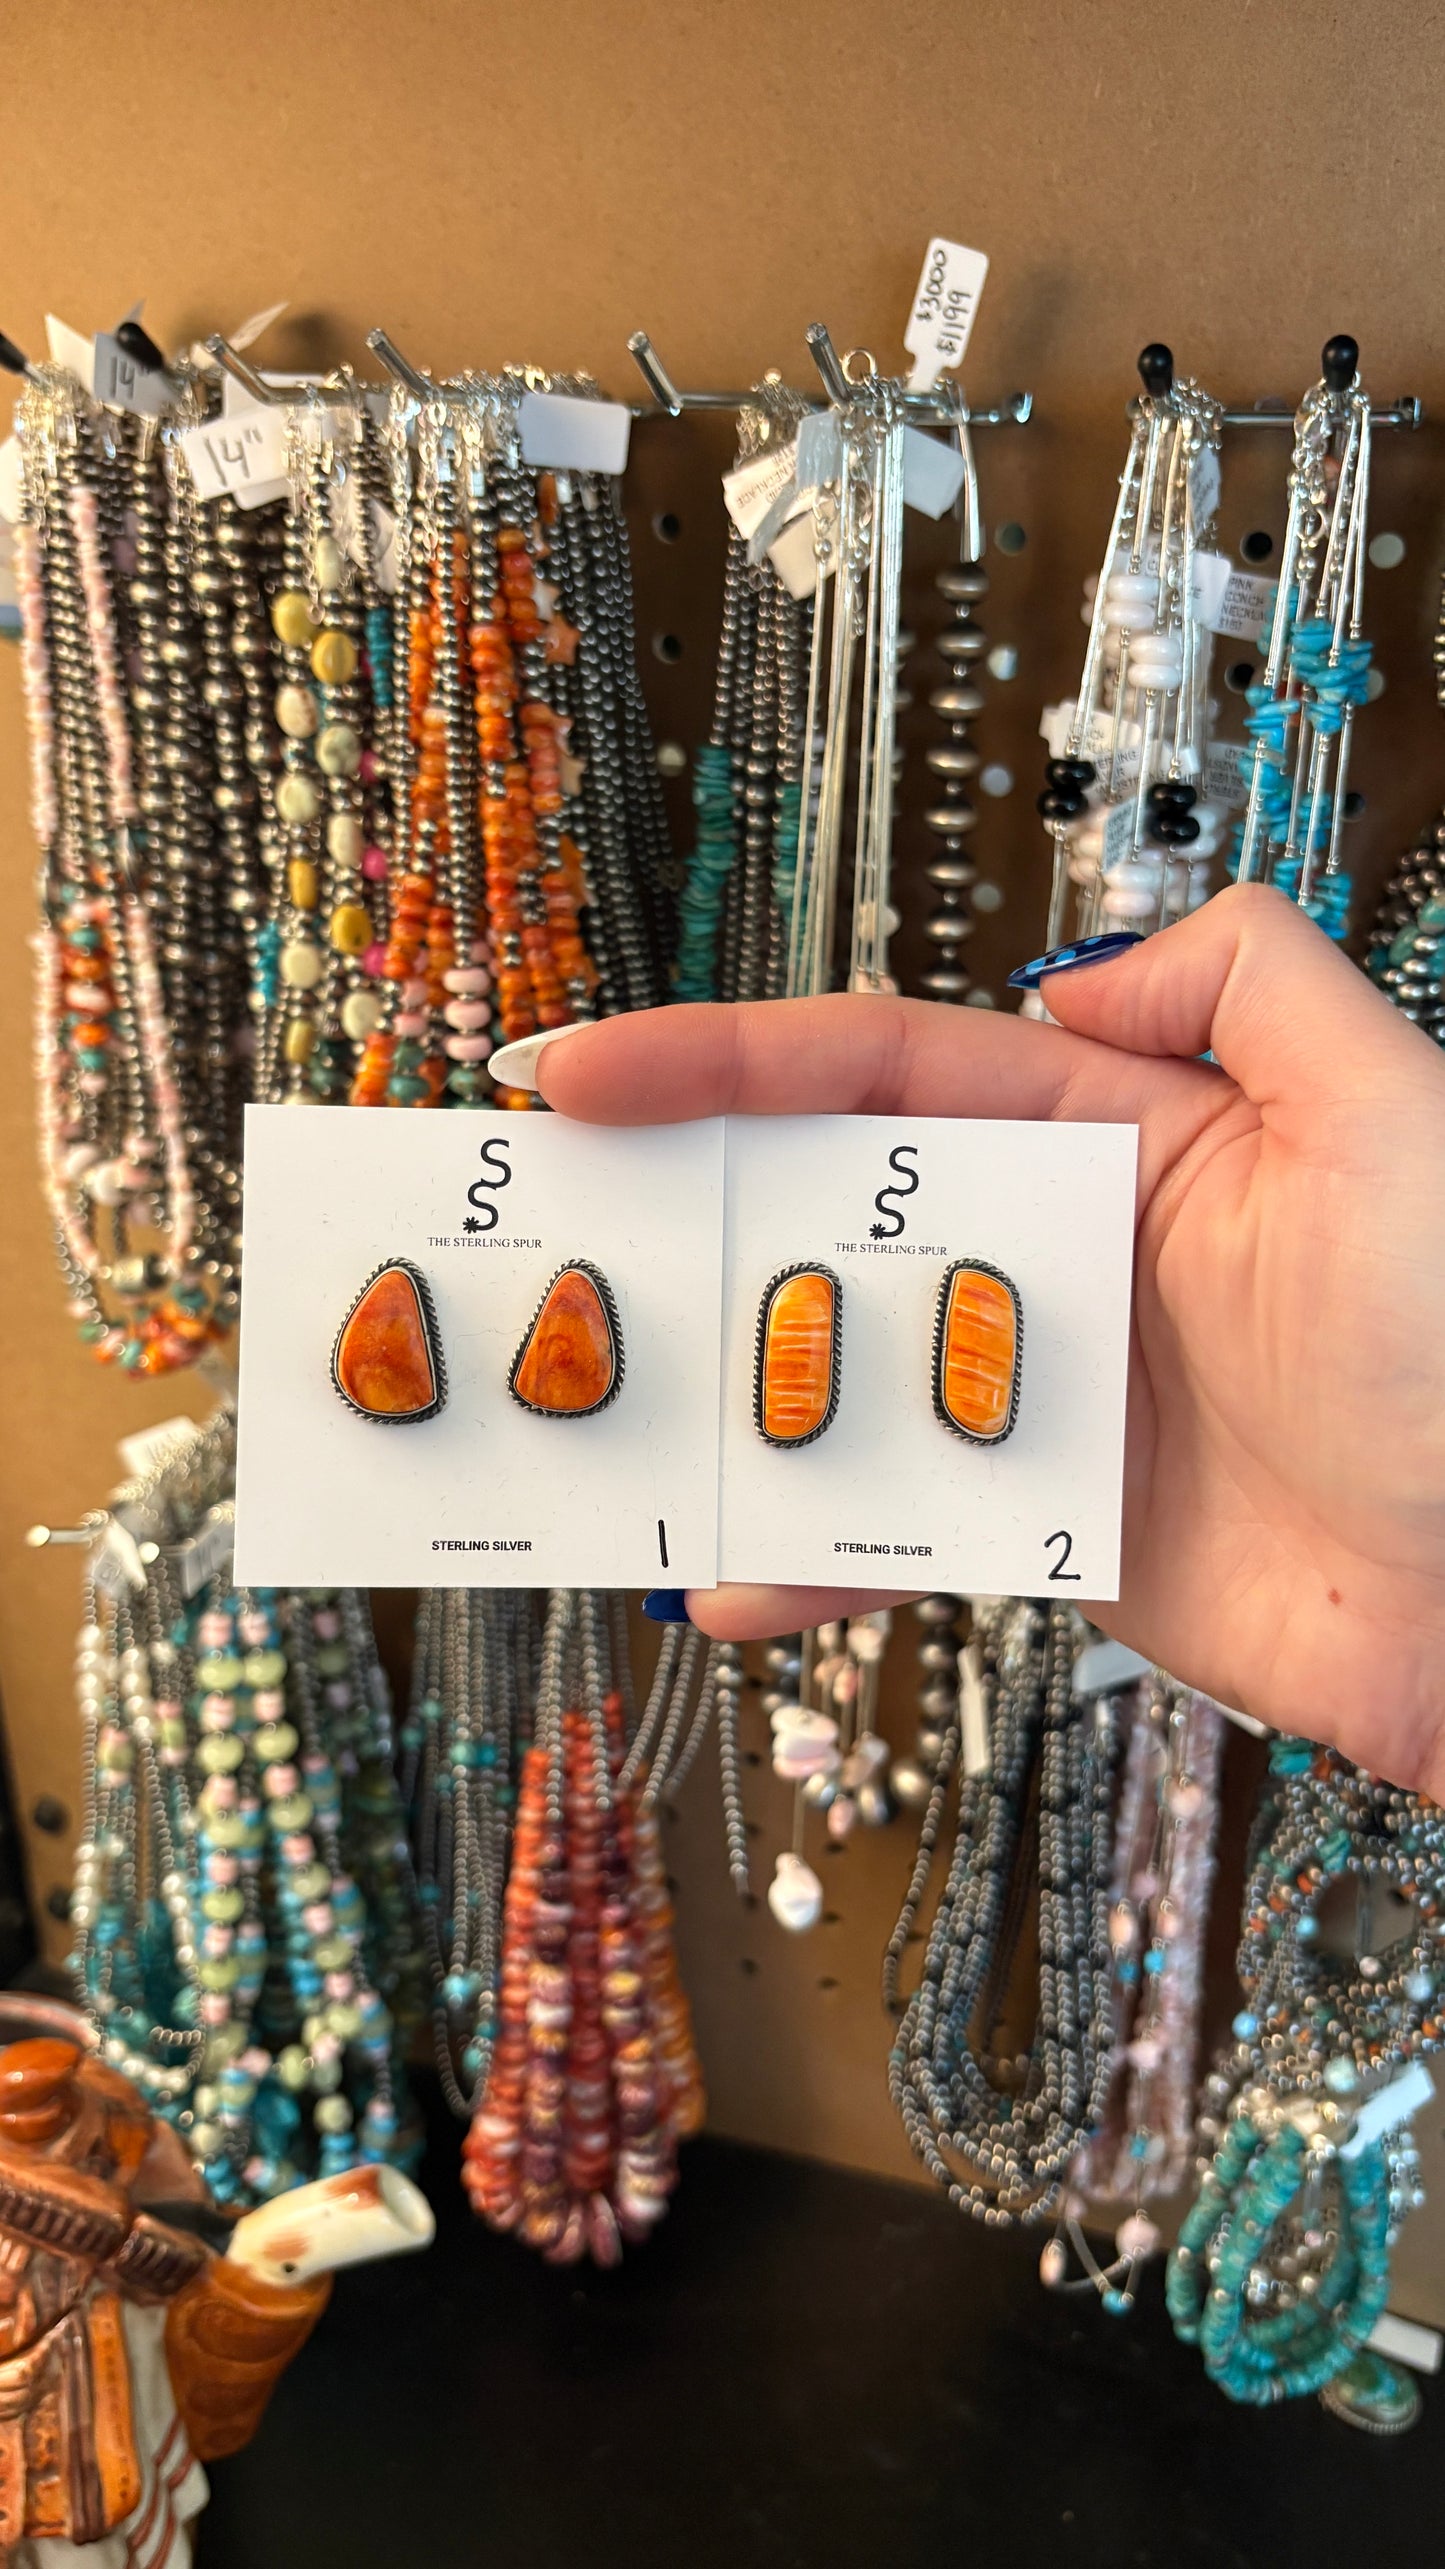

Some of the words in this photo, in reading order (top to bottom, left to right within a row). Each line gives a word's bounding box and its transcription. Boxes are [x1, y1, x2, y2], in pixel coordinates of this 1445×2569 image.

[916, 249, 946, 321] $3000
[936, 289, 972, 355] $1199
[204, 427, 262, 488] 14"
[427, 1237, 451, 1247] THE
[453, 1237, 511, 1248] STERLING
[513, 1238, 542, 1249] SPUR
[834, 1242, 858, 1253] THE
[860, 1243, 916, 1255] STERLING
[918, 1245, 948, 1256] SPUR
[431, 1540, 490, 1551] STERLING
[492, 1540, 533, 1552] SILVER
[833, 1542, 891, 1555] STERLING
[893, 1544, 933, 1557] SILVER
[1044, 1530, 1082, 1581] 2
